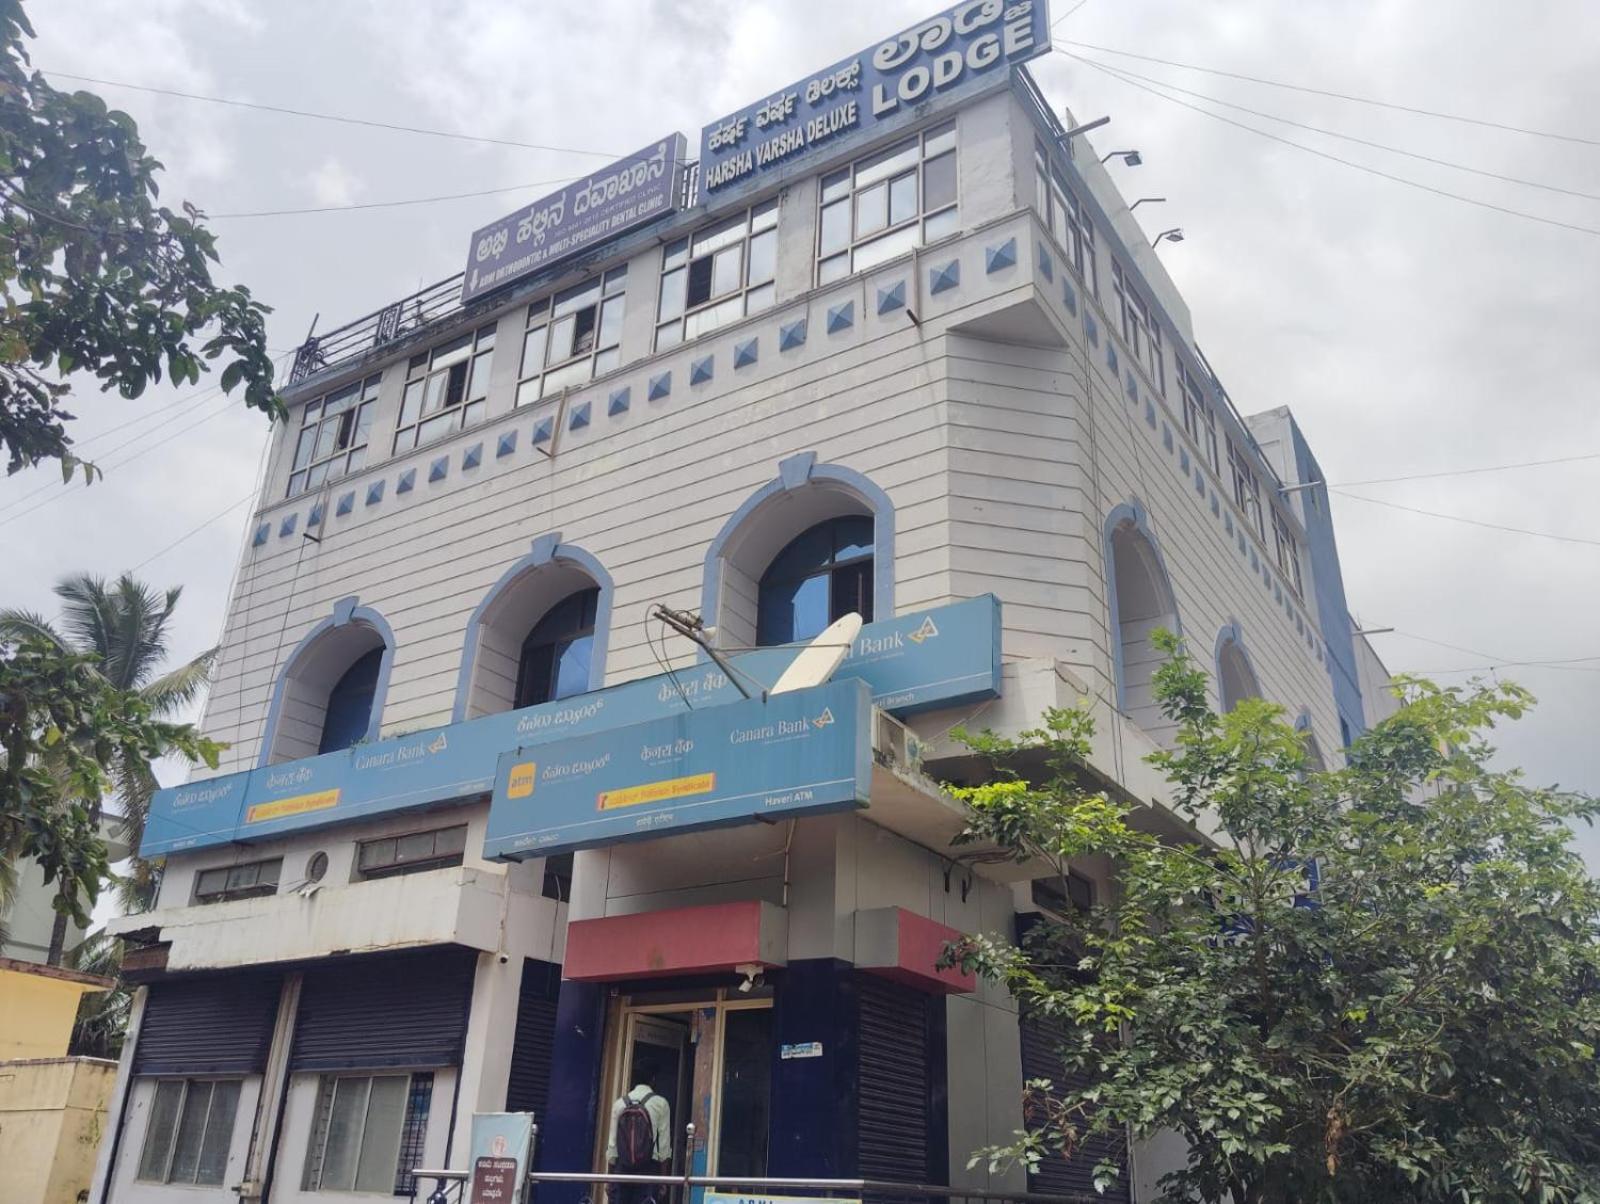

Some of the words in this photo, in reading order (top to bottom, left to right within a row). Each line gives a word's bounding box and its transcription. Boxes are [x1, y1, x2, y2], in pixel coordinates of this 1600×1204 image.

[872, 16, 1034, 115] LODGE
[705, 150, 753, 190] HARSHA
[755, 126, 804, 165] VARSHA
[807, 101, 857, 143] DELUXE
[516, 191, 567, 247] ಹಲ್ಲಿನ
[573, 141, 667, 216] ದವಾಖಾನೆ
[610, 206, 638, 228] DENTAL
[637, 193, 664, 216] CLINIC
[860, 630, 904, 657] Bank
[730, 726, 774, 745] Canara
[778, 716, 810, 735] Bank
[355, 753, 395, 770] Canara
[397, 742, 426, 761] Bank
[765, 793, 793, 807] Haveri
[793, 791, 814, 802] ATM
